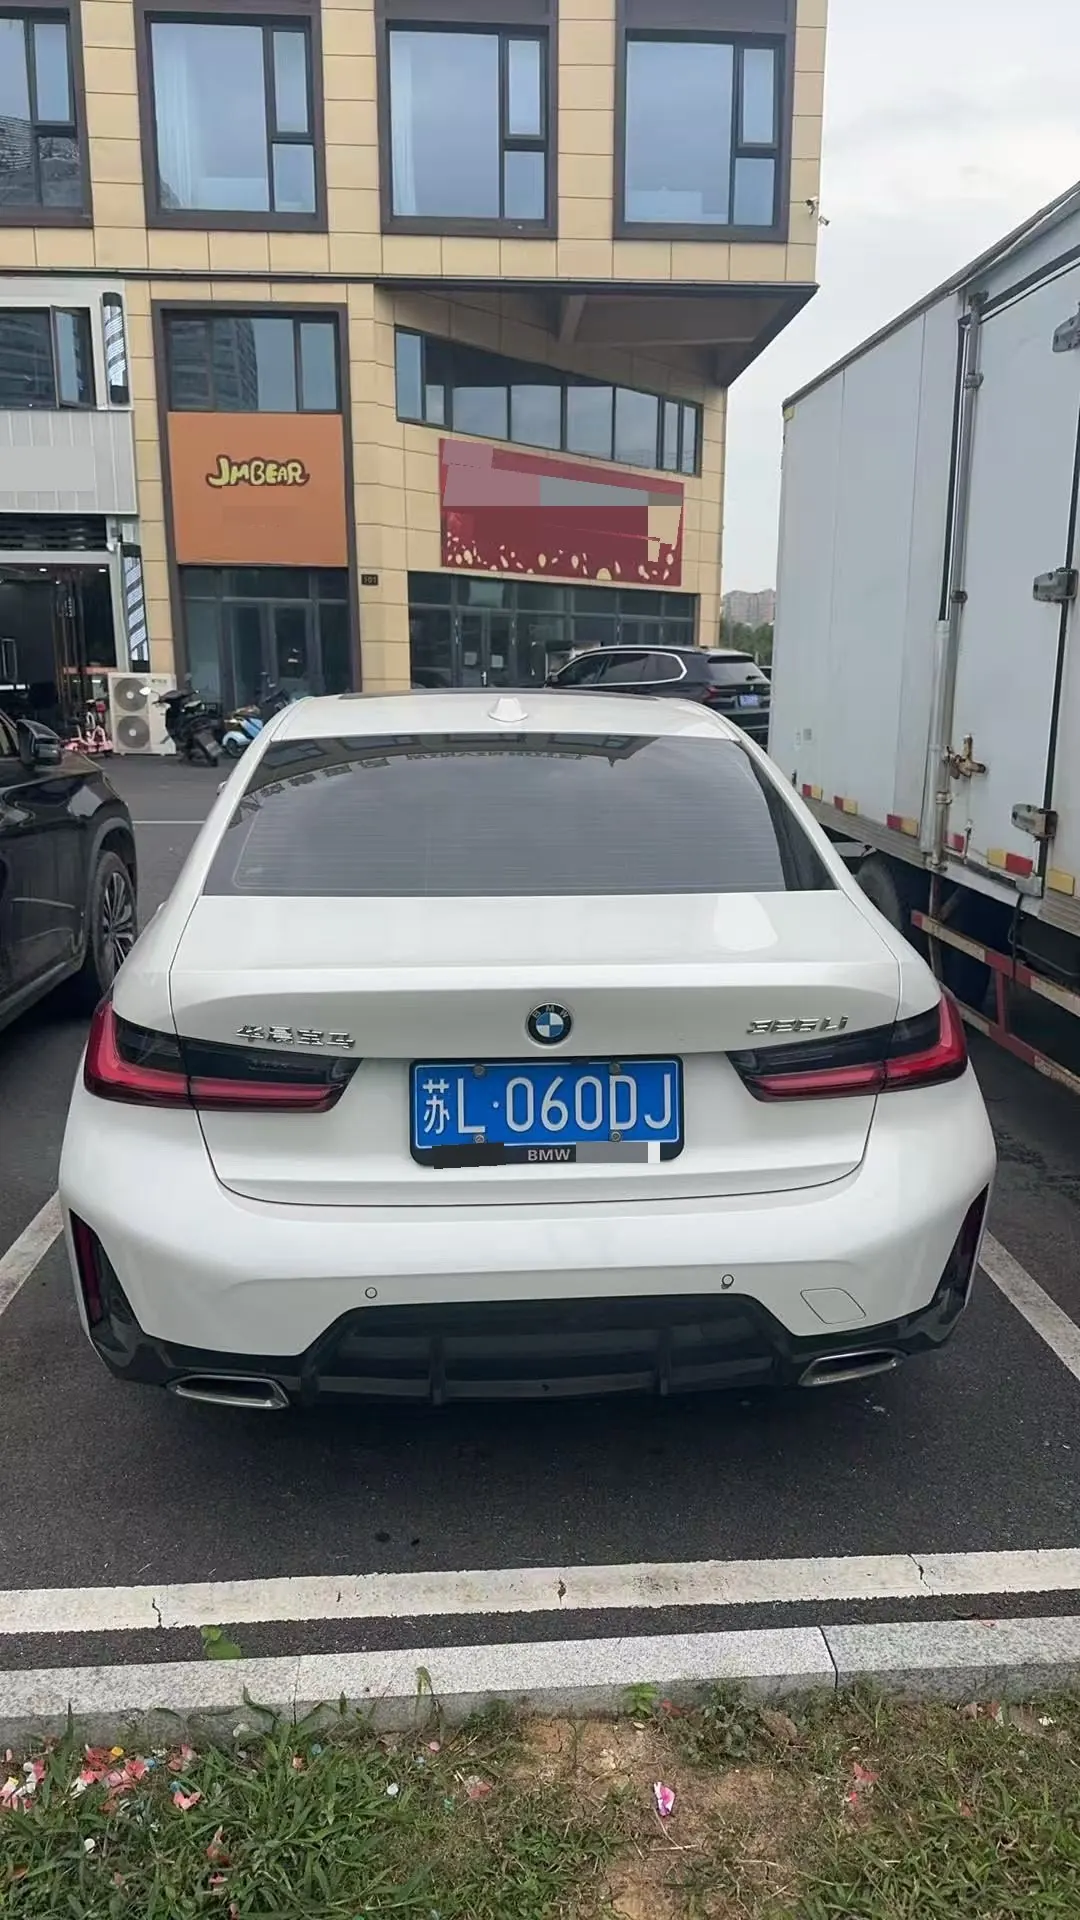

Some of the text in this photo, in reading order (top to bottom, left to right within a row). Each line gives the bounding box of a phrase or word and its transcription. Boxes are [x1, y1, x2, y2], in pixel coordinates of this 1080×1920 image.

[206, 455, 309, 487] JMBEAR
[532, 1005, 569, 1019] BMW
[235, 1024, 356, 1049] 华晨宝马
[527, 1148, 571, 1162] BMW
